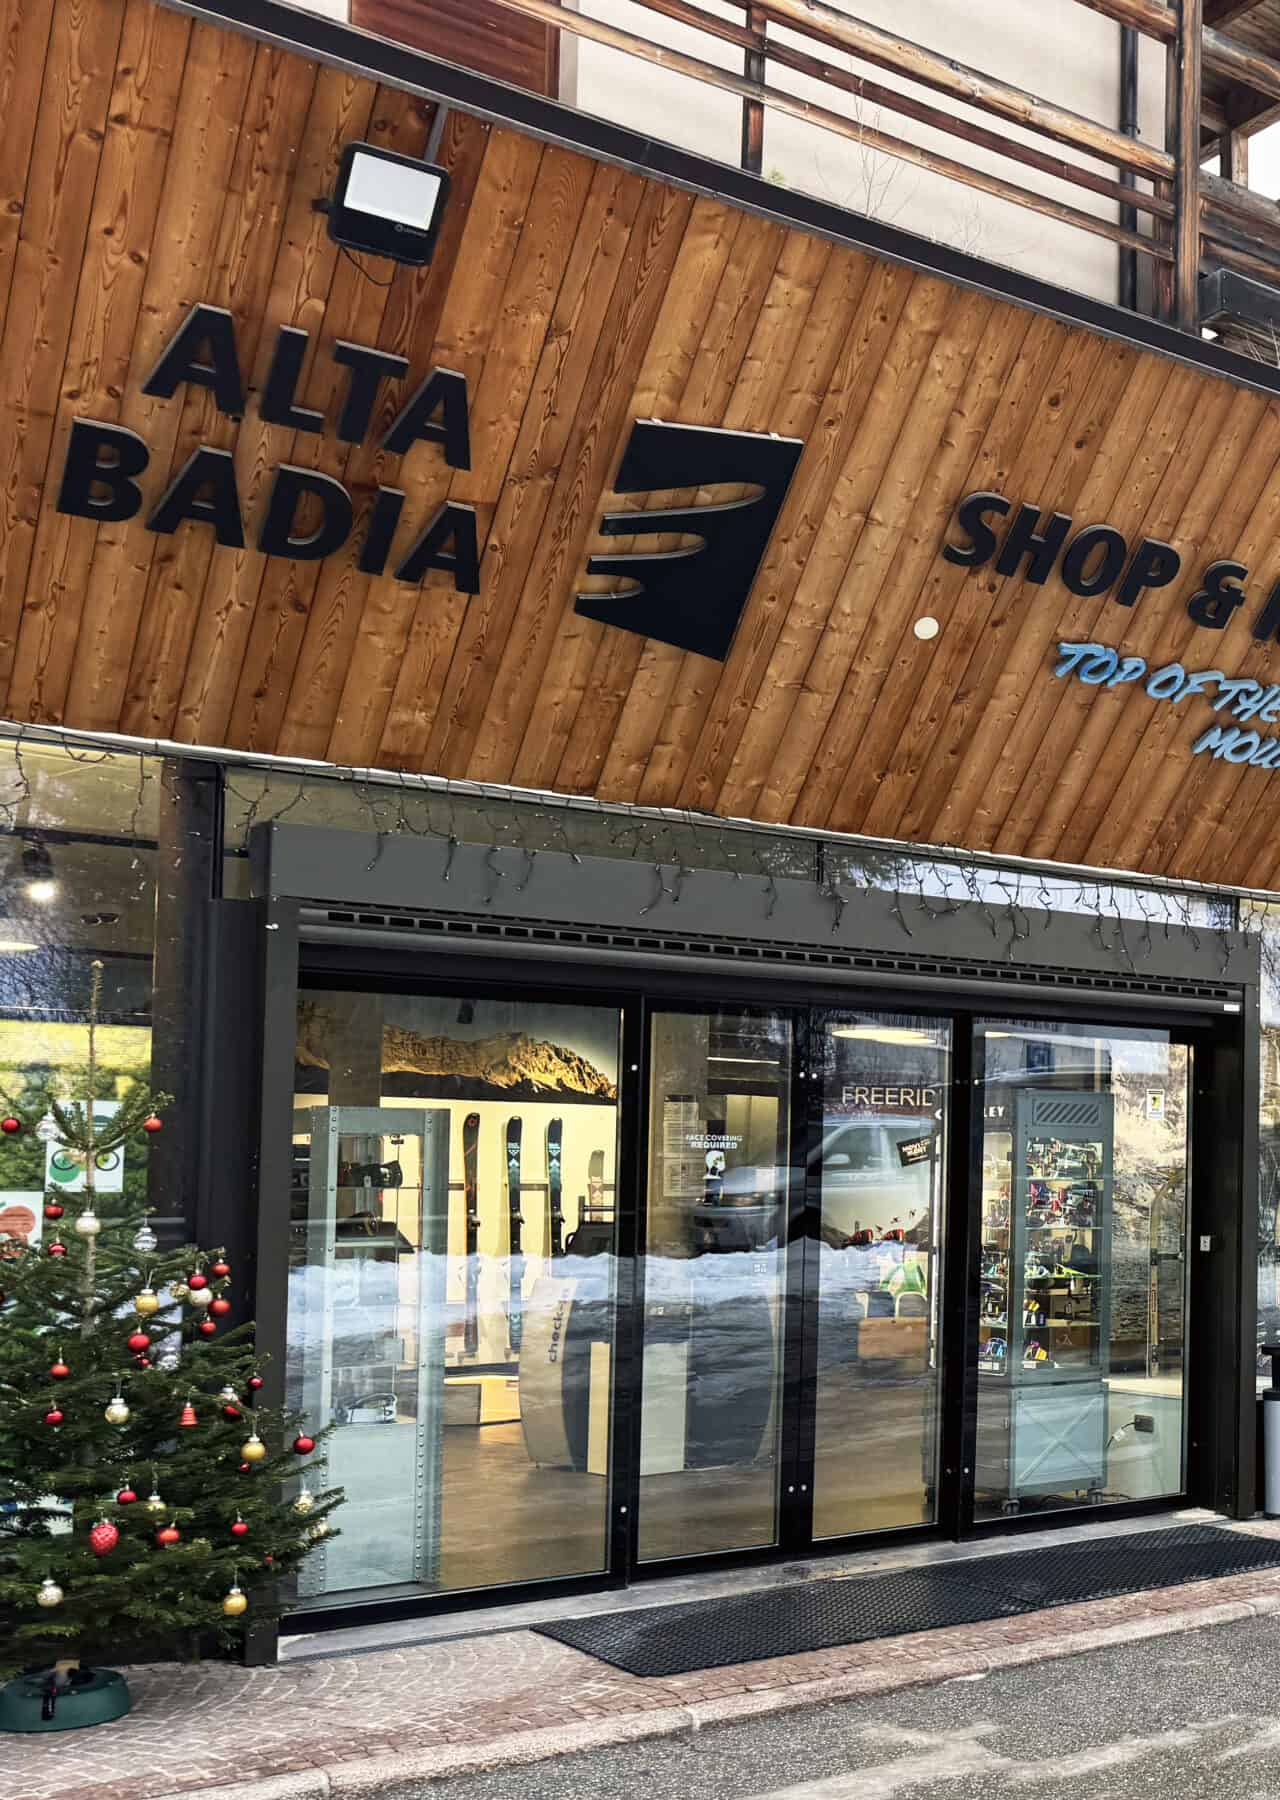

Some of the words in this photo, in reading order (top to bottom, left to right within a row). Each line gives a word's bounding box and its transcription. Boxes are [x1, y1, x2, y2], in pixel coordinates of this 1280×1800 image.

[141, 303, 471, 471] ALTA
[56, 417, 482, 595] BADIA
[943, 491, 1181, 607] SHOP
[1187, 560, 1249, 630] &
[1055, 642, 1147, 688] TOP
[1146, 663, 1225, 704] OF
[842, 1086, 942, 1107] FREERID
[690, 1141, 738, 1150] REQUIRED
[705, 1134, 743, 1142] COVERING
